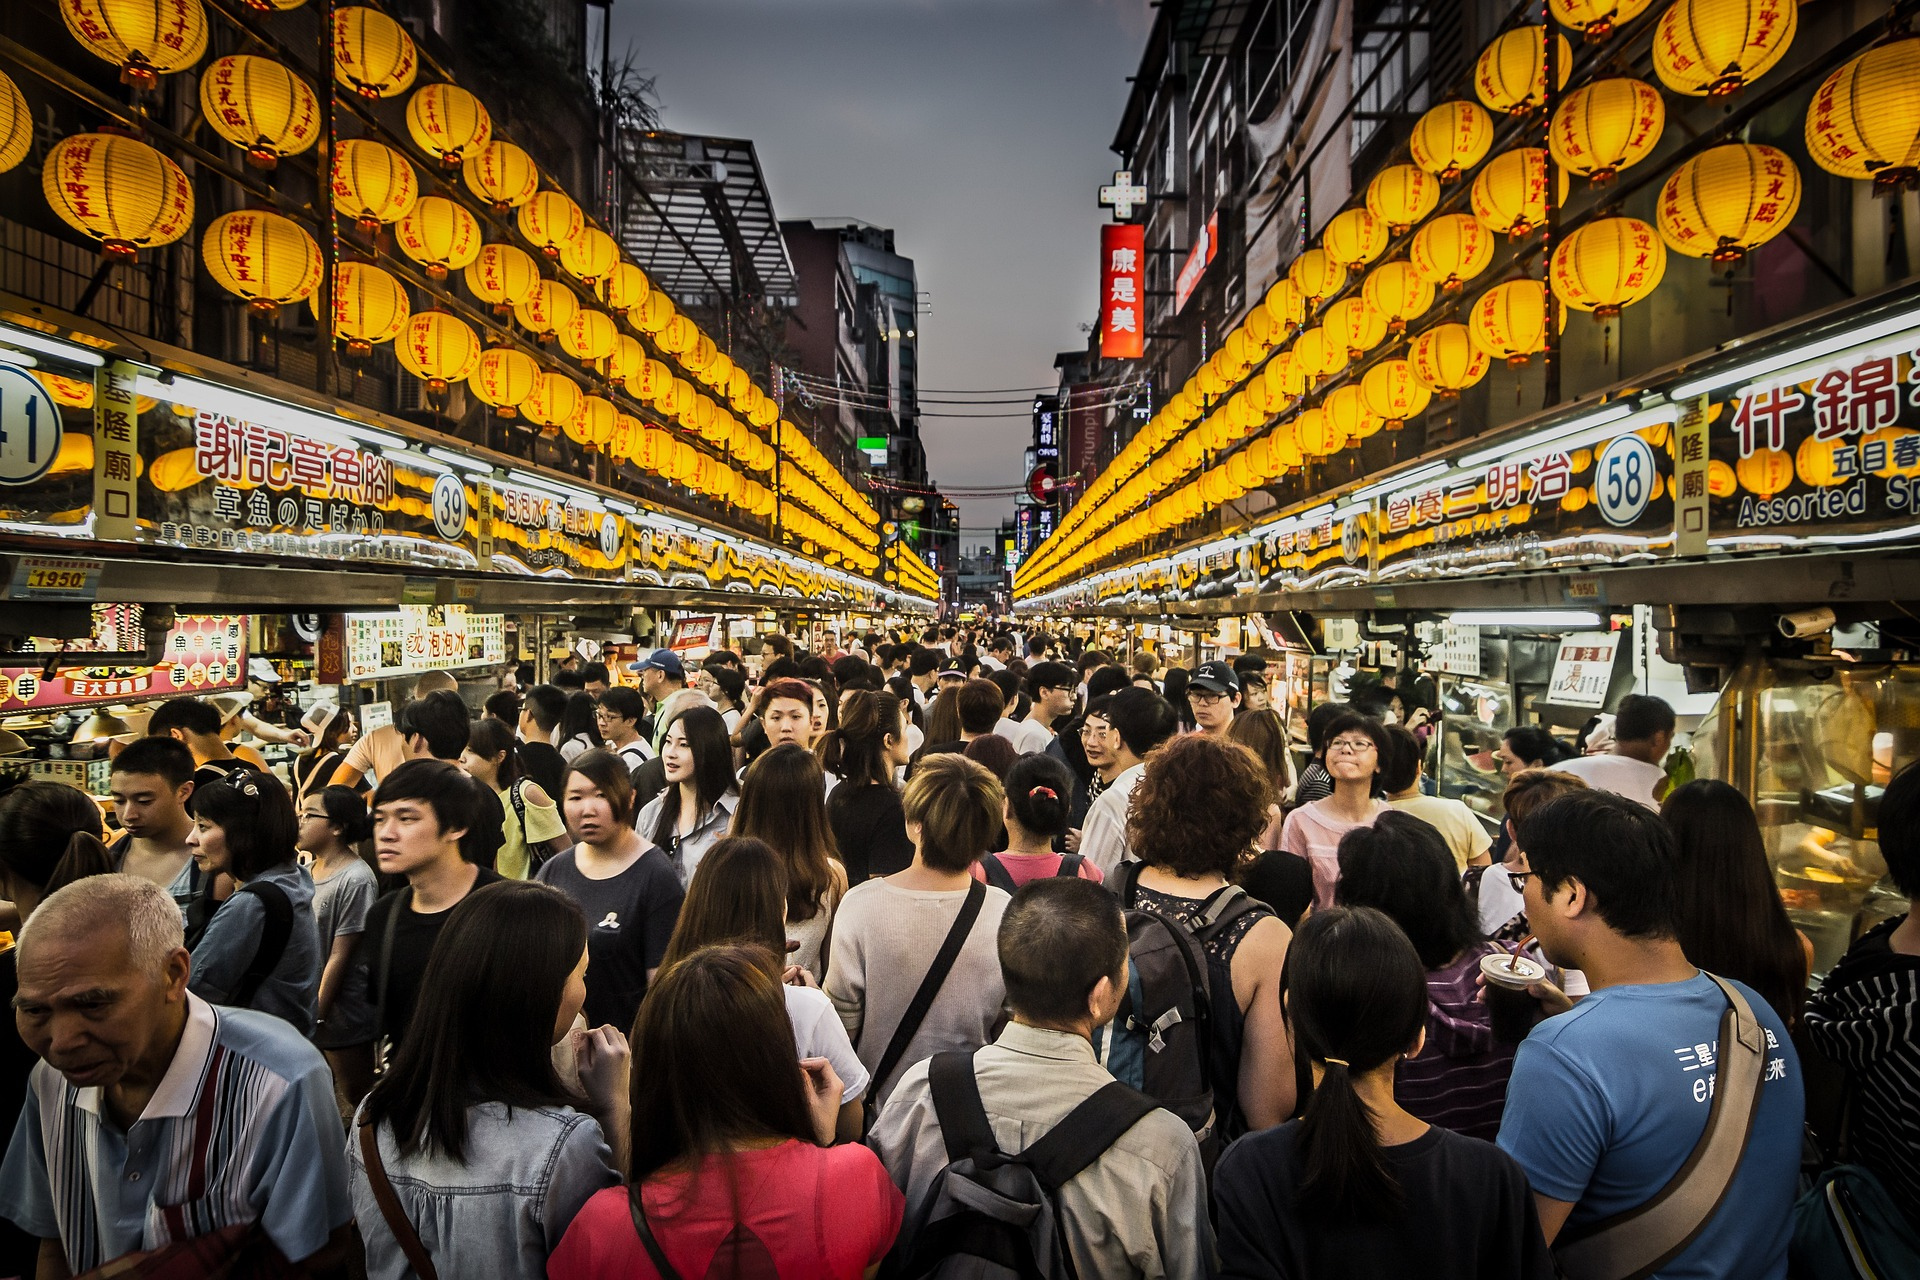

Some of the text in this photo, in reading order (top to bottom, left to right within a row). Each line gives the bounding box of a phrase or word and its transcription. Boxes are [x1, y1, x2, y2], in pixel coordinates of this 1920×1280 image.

[1111, 247, 1137, 333] 康是美
[0, 387, 38, 464] 1
[1731, 346, 1920, 460] 什錦
[103, 370, 131, 519] 基隆廟口
[197, 411, 395, 507] 謝記章魚腳
[1682, 398, 1703, 532] 基隆廟口
[441, 485, 463, 528] 39
[1388, 450, 1571, 532] 營養三明治
[1607, 450, 1641, 510] 58
[1737, 478, 1867, 528] Assorted
[212, 486, 386, 539] 章魚の足ばかり
[604, 522, 615, 553] 37
[1345, 523, 1358, 554] 56
[37, 571, 82, 587] 1950
[526, 547, 565, 566] Pao-Pao
[428, 630, 466, 657] 泡泡冰
[1765, 1057, 1787, 1081] 來
